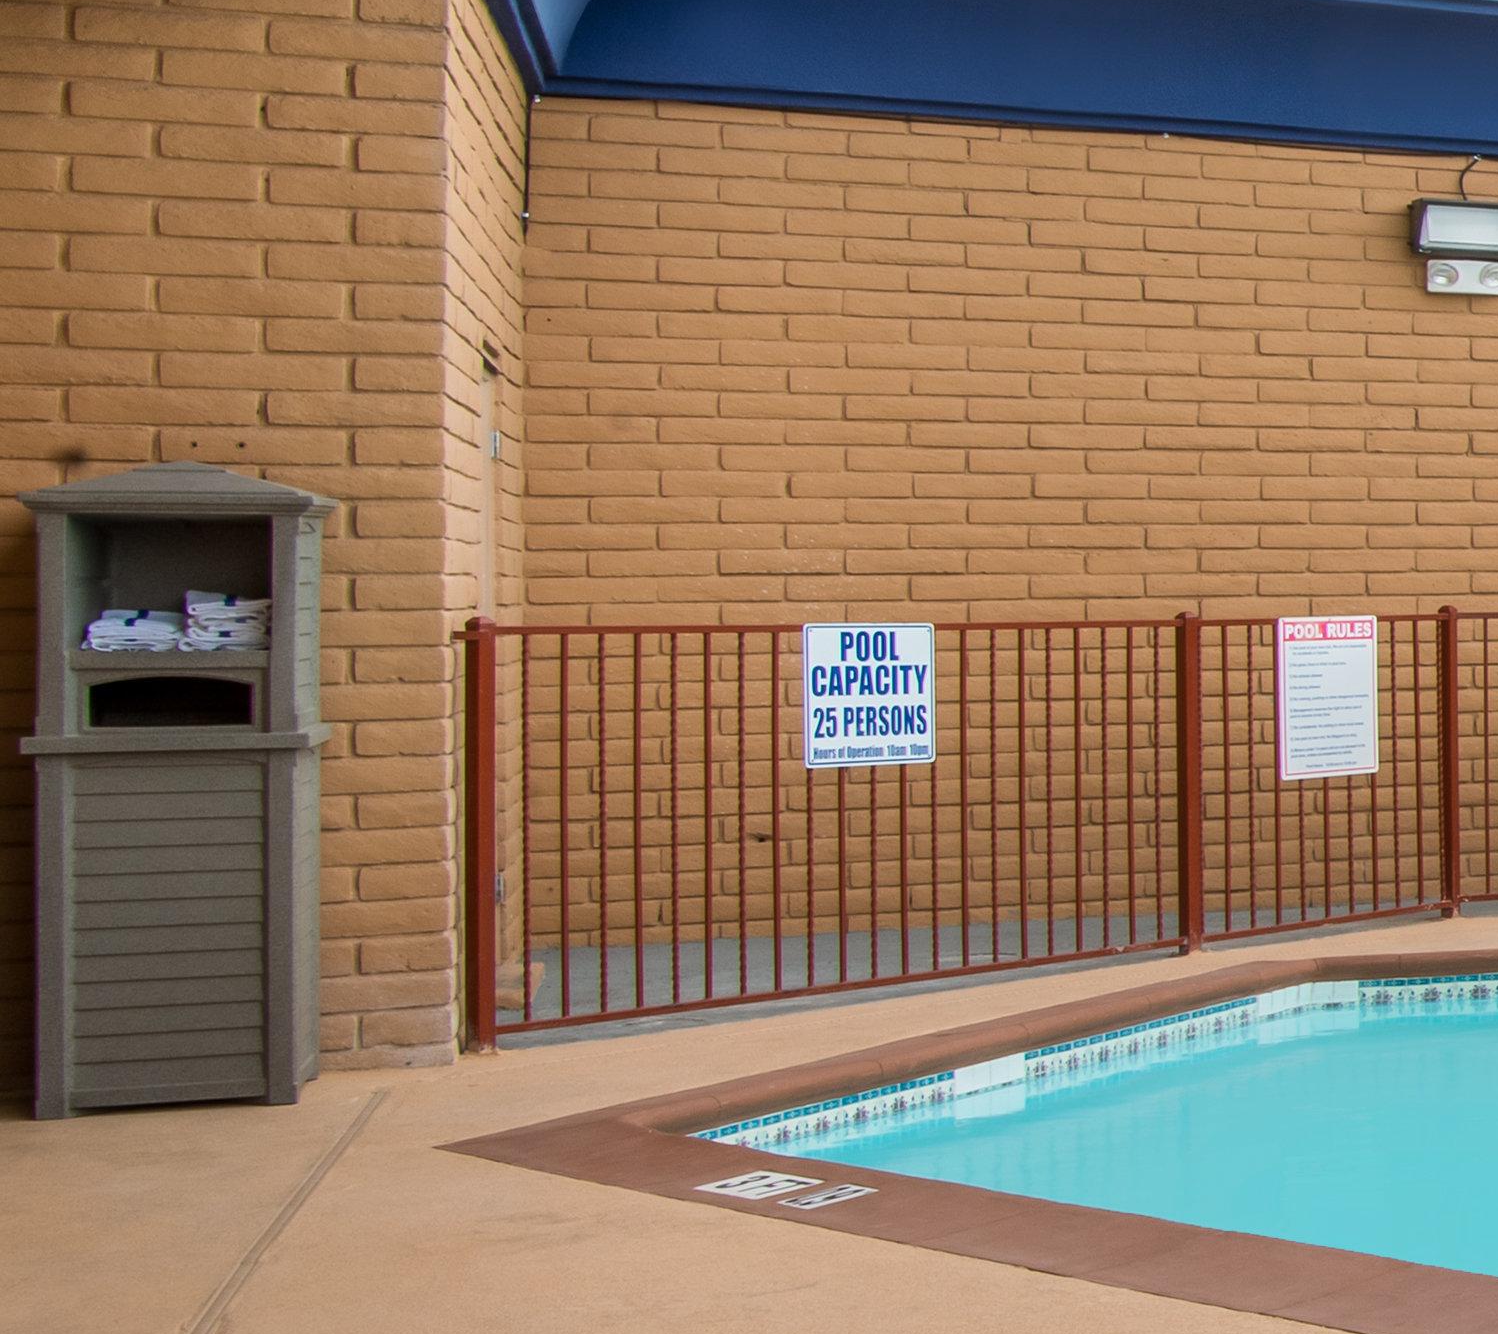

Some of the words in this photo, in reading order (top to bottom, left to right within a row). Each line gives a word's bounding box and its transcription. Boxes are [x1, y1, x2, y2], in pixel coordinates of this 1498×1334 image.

[1284, 623, 1323, 639] POOL
[1326, 622, 1372, 638] RULES
[840, 631, 899, 662] POOL
[811, 664, 928, 697] CAPACITY
[813, 707, 837, 738] 25
[843, 704, 927, 737] PERSONS
[813, 747, 836, 759] Hours
[838, 747, 845, 758] of
[847, 746, 884, 758] Operation
